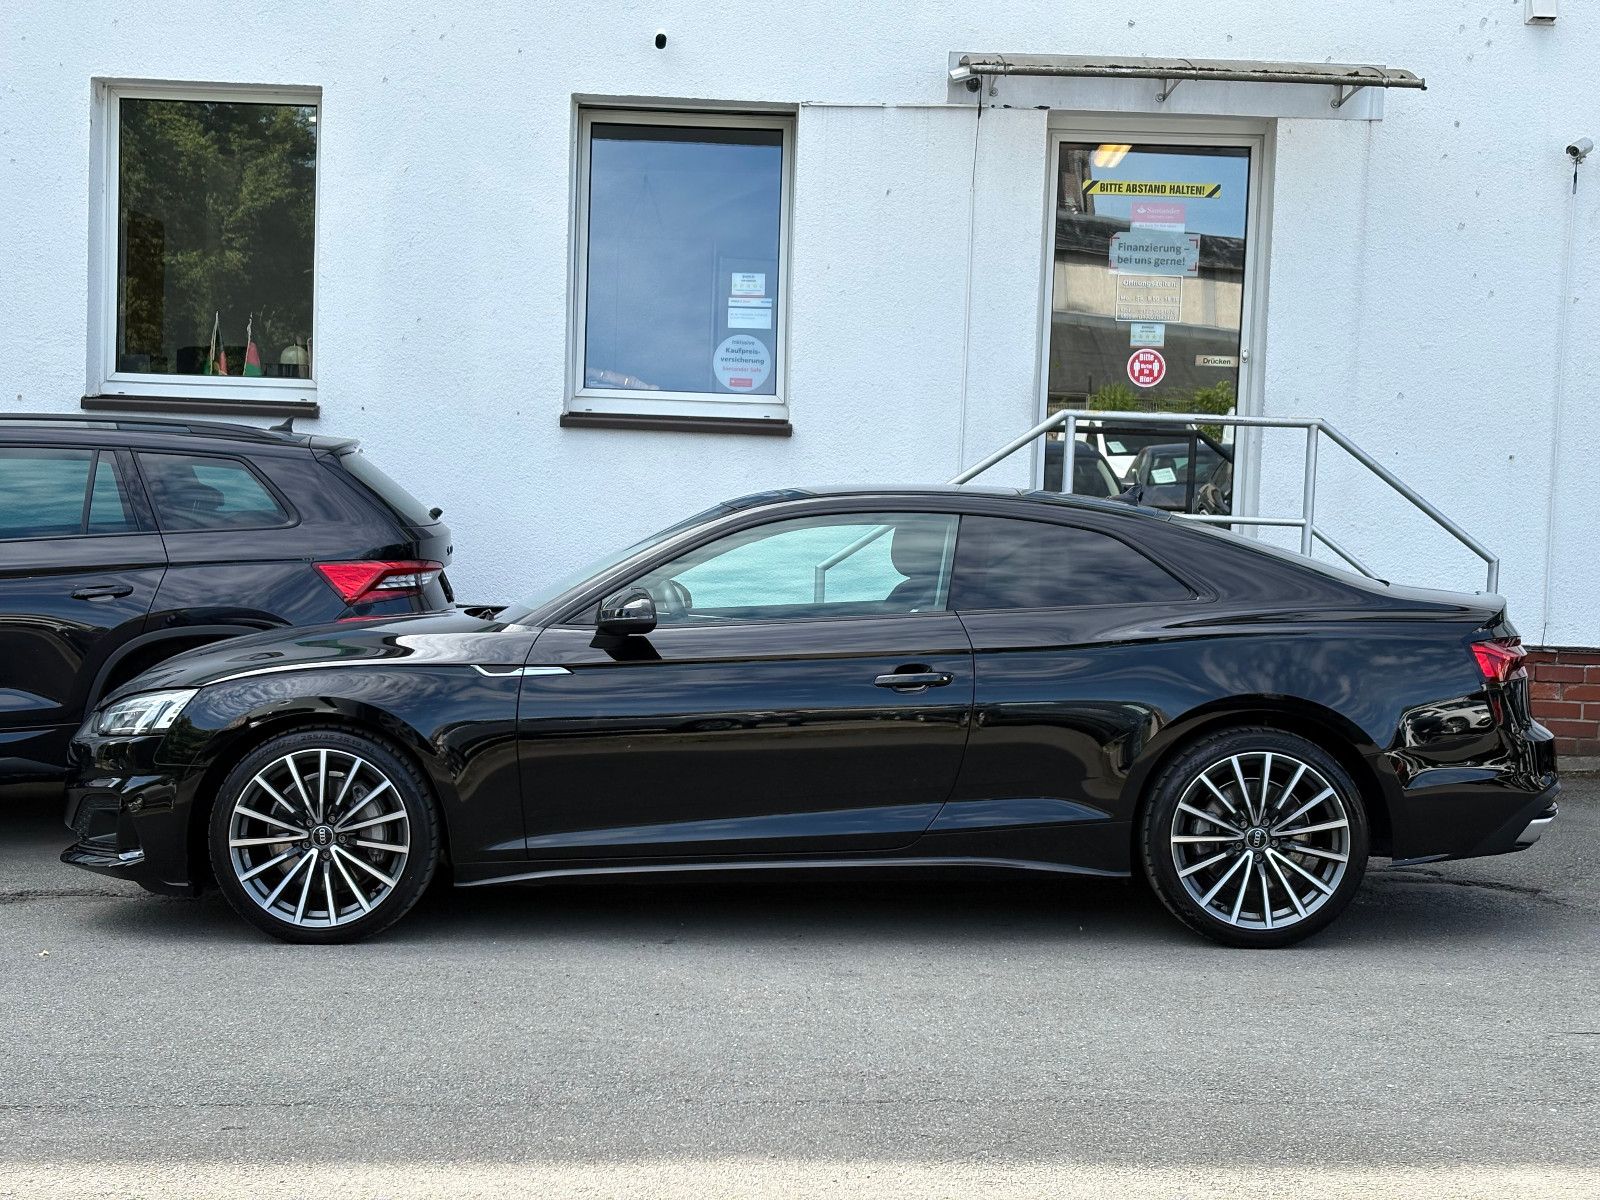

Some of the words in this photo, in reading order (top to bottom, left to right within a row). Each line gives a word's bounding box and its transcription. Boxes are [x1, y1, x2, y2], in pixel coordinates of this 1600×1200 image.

[1100, 182, 1123, 193] BITTE
[1125, 183, 1166, 194] ABSTAND
[1169, 184, 1205, 196] HALTEN!
[1118, 242, 1182, 255] Finanzierung
[1117, 255, 1132, 264] bei
[1134, 257, 1152, 265] uns
[1154, 257, 1185, 267] gerne!
[725, 347, 761, 355] Kaufpreis-
[720, 356, 765, 365] versicherung
[1139, 353, 1155, 361] Bitte
[1202, 357, 1231, 365] Drücken
